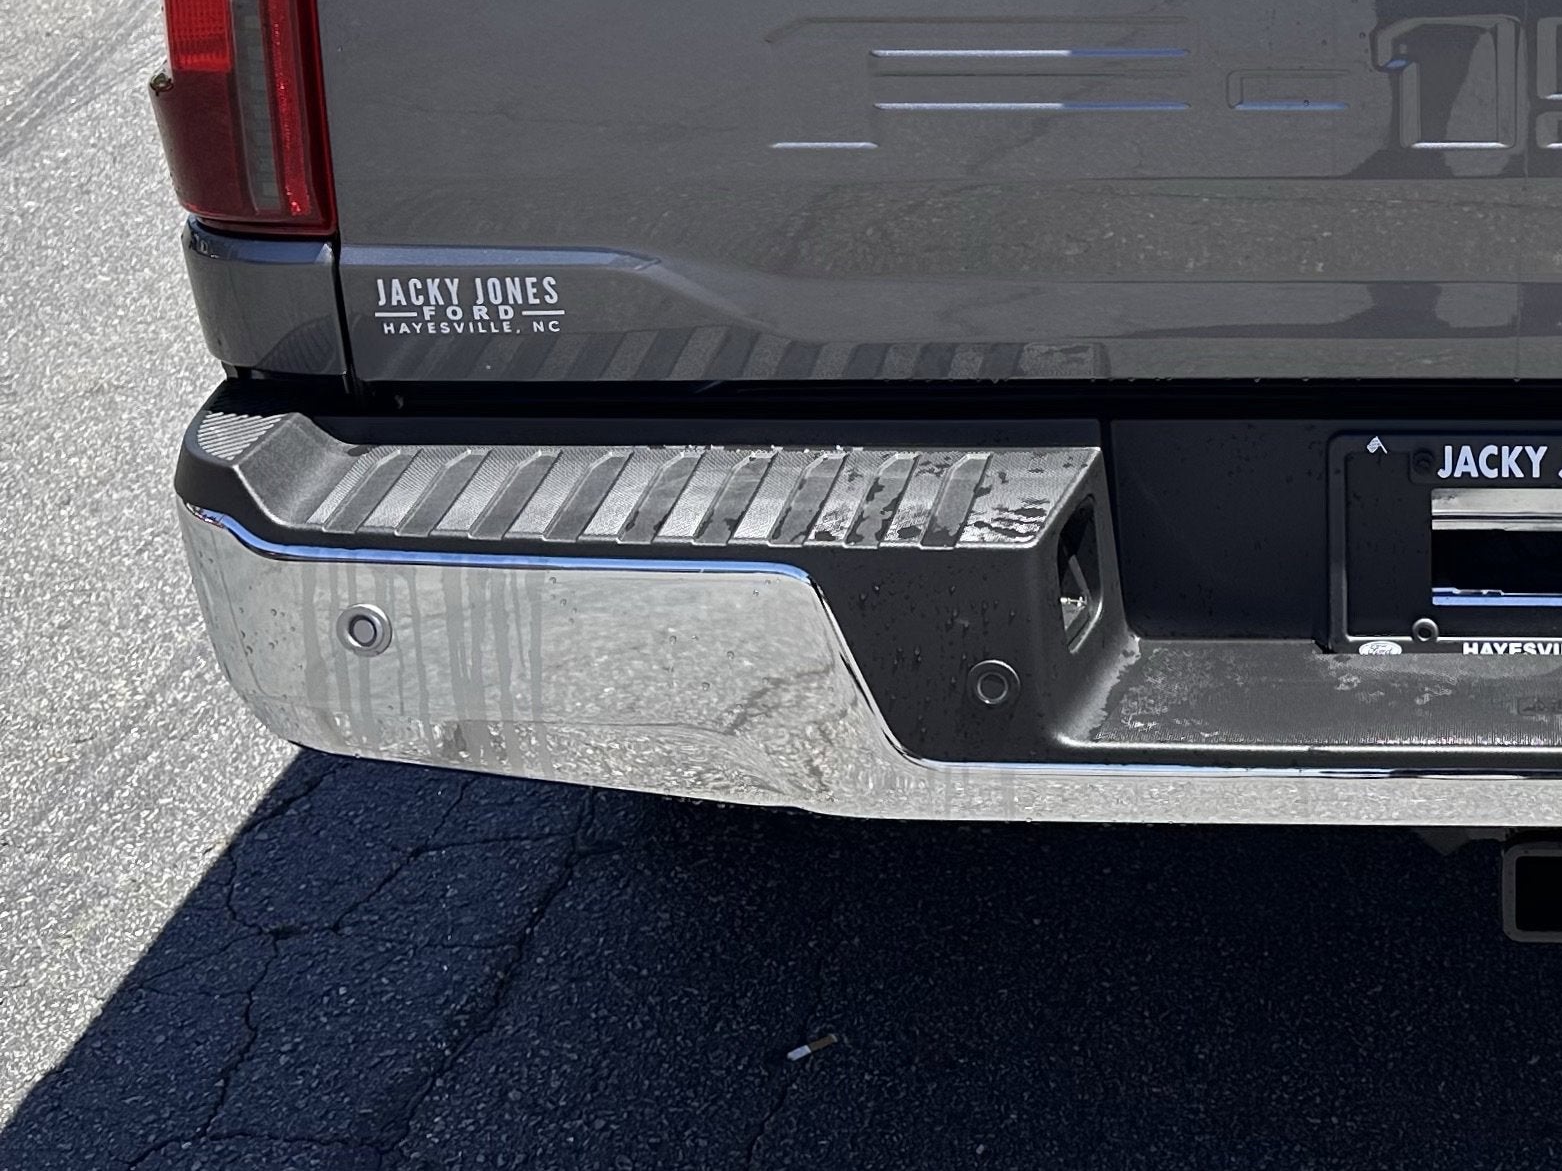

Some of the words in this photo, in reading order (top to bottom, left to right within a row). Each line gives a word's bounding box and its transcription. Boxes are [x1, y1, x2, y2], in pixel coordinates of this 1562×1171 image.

[375, 277, 461, 307] JACKY
[473, 276, 560, 306] JONES
[422, 305, 515, 321] FORD
[383, 321, 522, 335] HAYESVILLE,
[532, 320, 561, 333] NC
[1437, 444, 1548, 479] JACKY
